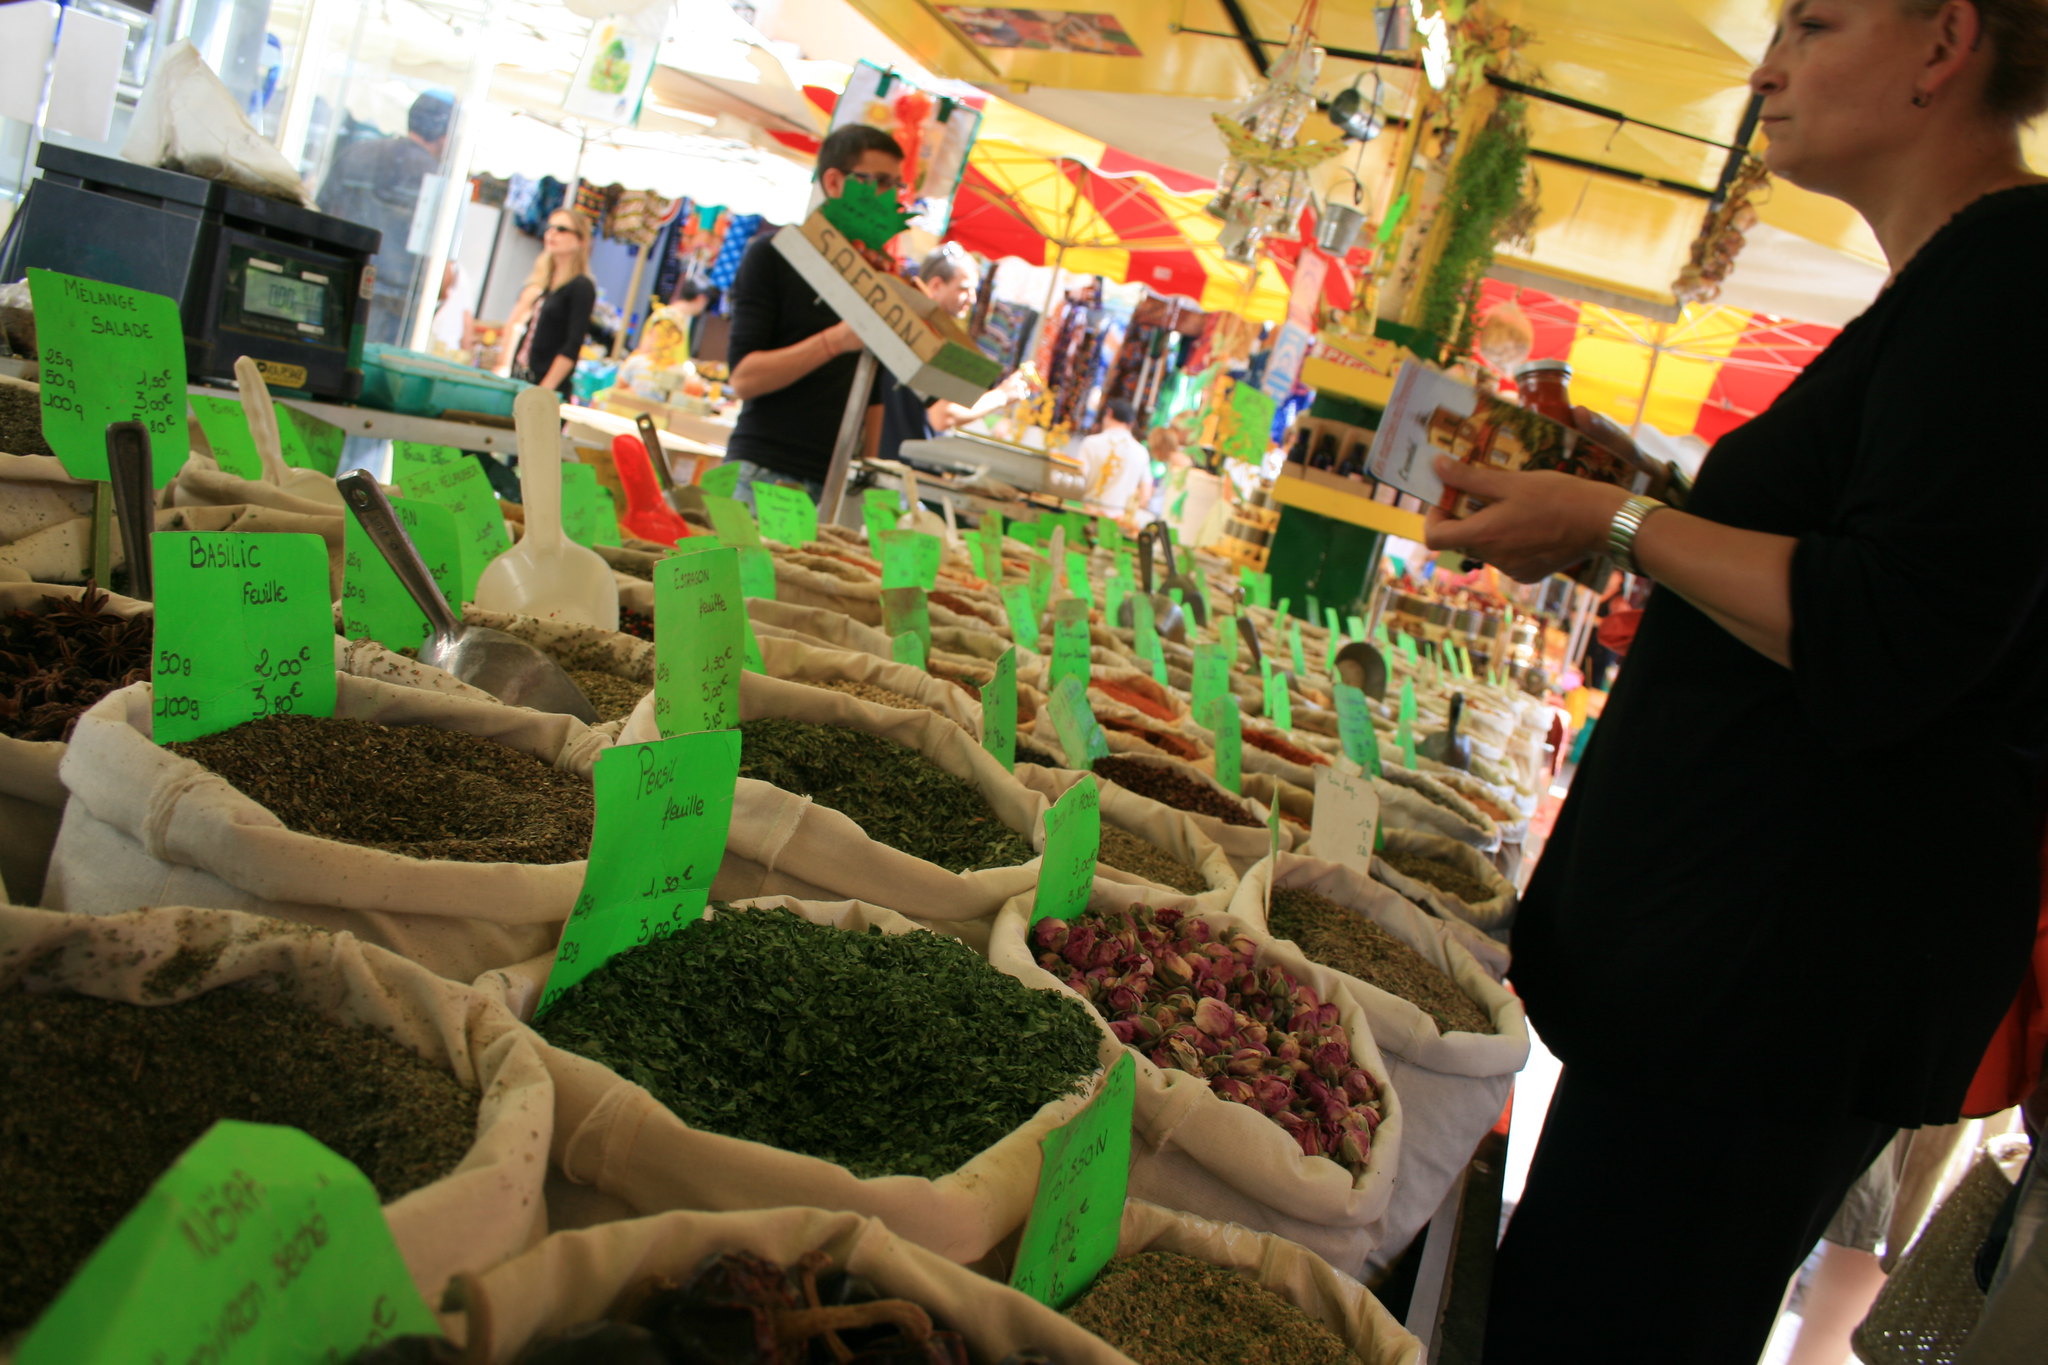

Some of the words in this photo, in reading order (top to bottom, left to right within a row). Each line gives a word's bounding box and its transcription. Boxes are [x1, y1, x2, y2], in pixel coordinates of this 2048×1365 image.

[816, 229, 924, 347] SAFRAN
[91, 316, 153, 339] SALADE
[254, 646, 311, 682] 2,00€
